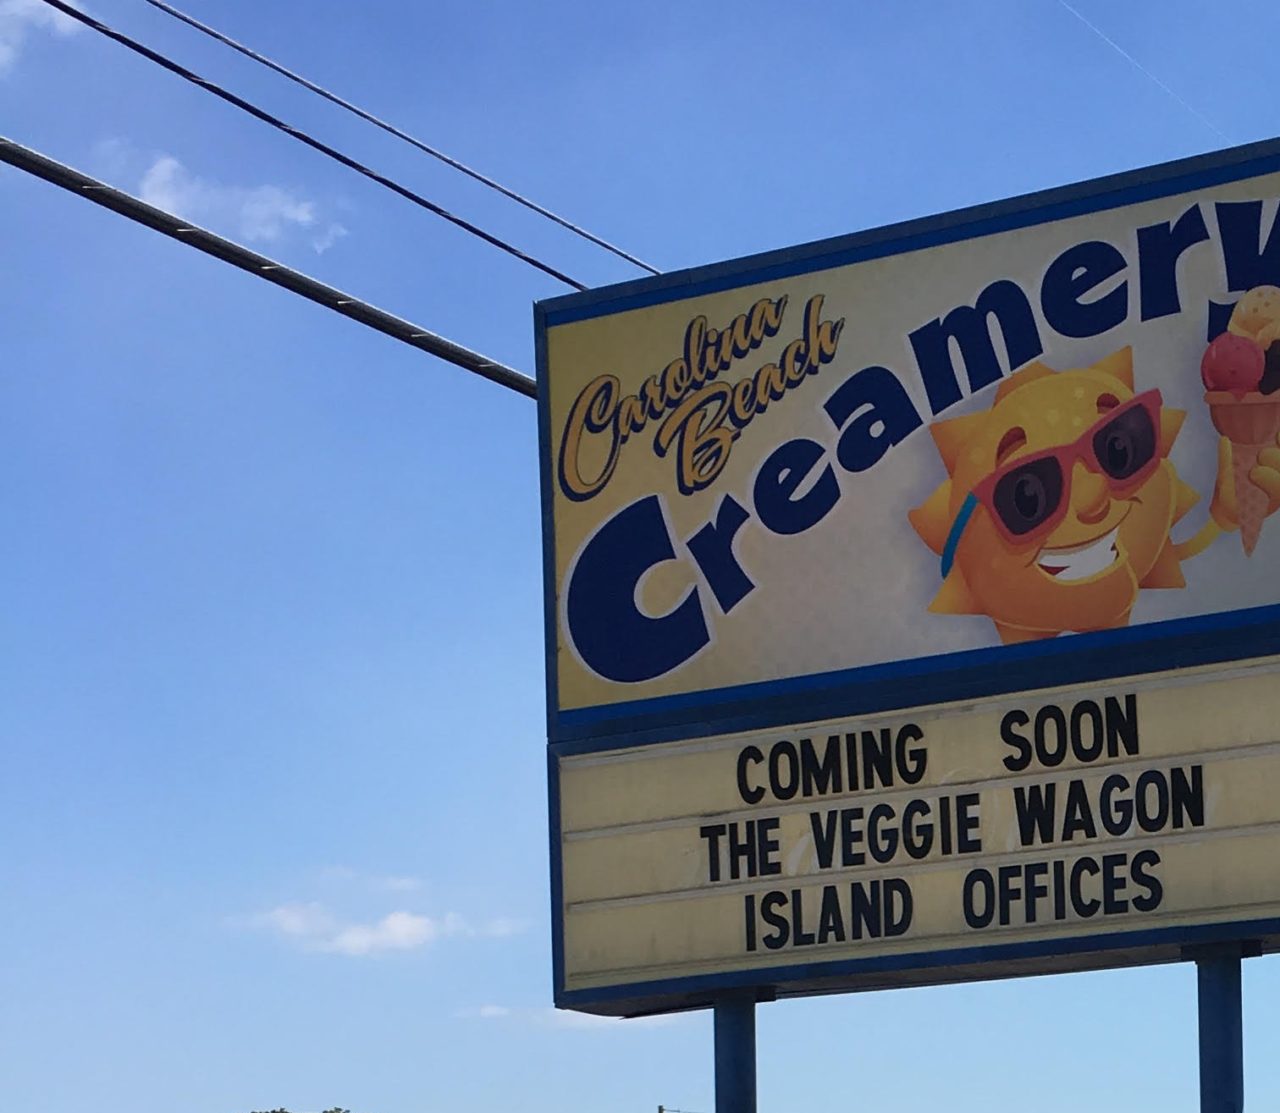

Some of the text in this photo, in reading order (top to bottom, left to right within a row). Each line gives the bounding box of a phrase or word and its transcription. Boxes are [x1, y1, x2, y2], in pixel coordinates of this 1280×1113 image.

[558, 294, 788, 501] Carolina
[653, 294, 845, 495] Beach
[737, 694, 1139, 804] COMING SOON
[700, 765, 1205, 882] THE VEGGIE WAGON
[745, 850, 1163, 952] ISLAND OFFICES
